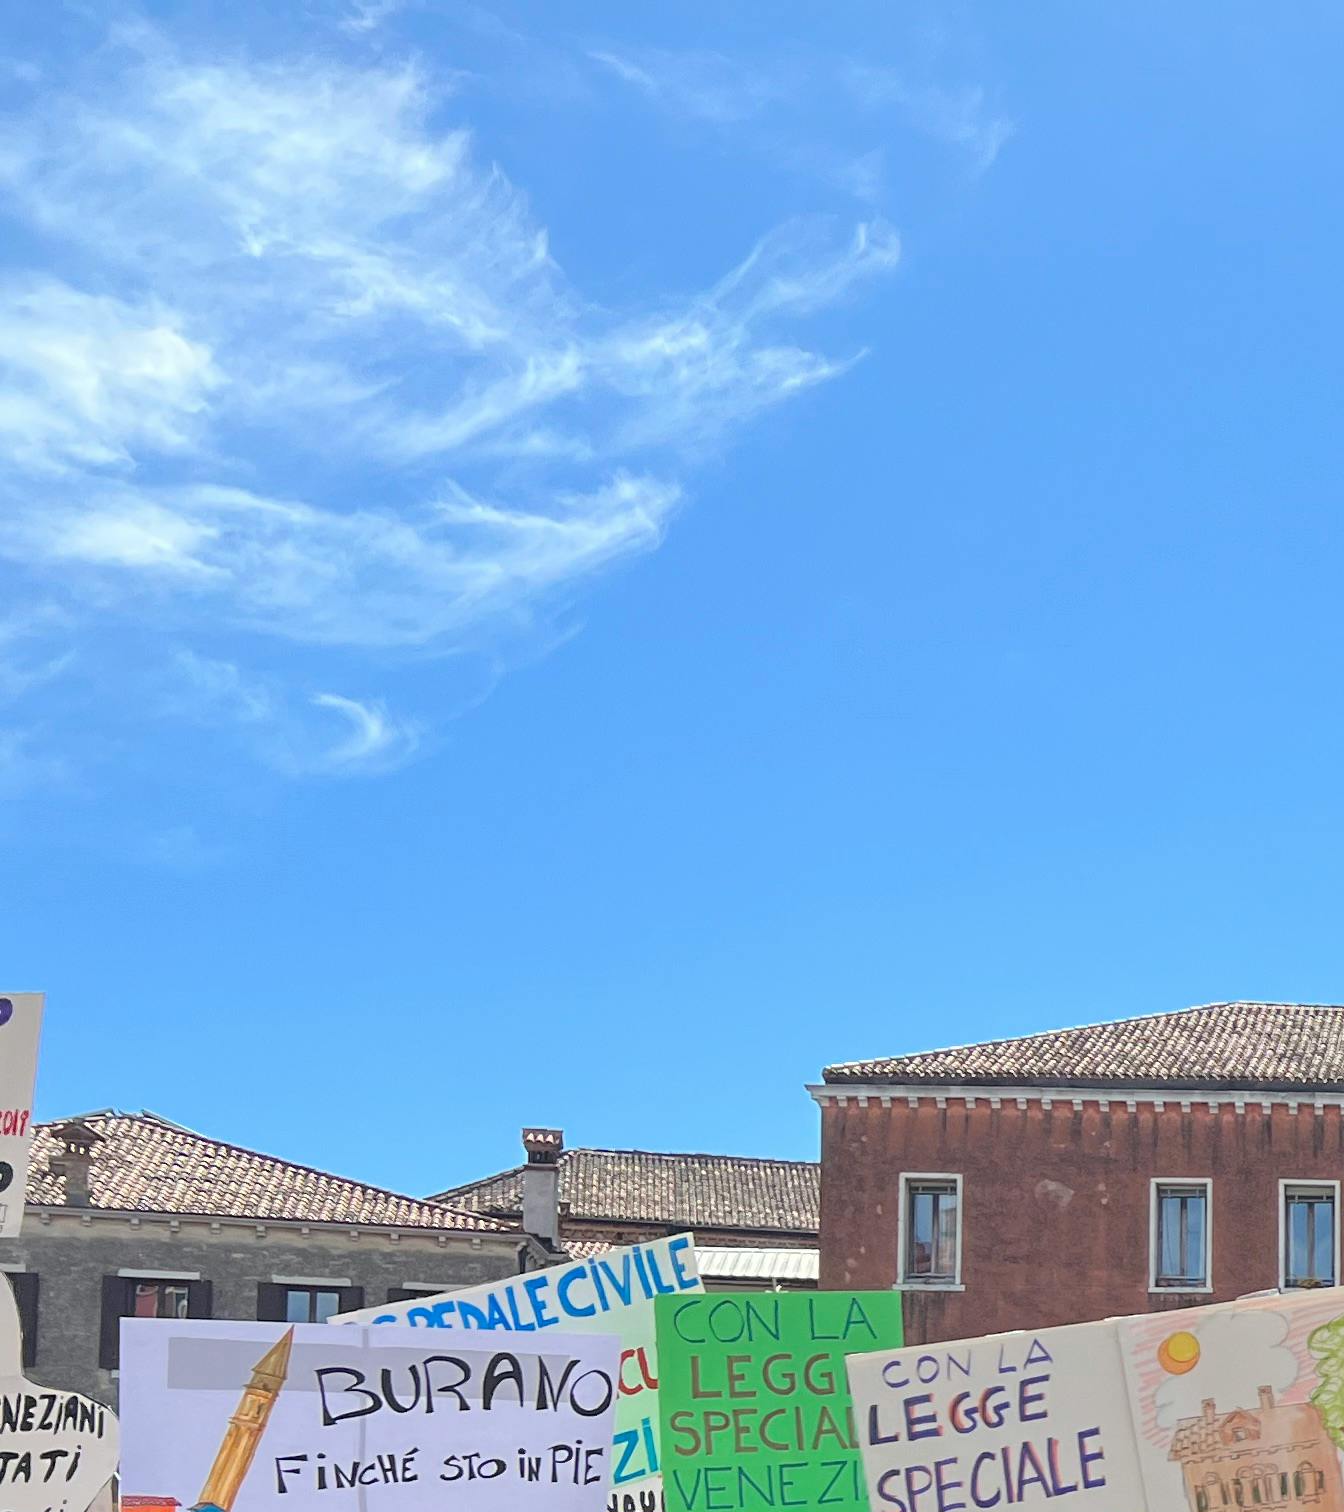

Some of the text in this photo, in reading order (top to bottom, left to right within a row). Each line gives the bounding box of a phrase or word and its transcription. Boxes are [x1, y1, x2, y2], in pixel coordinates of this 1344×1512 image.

[674, 1298, 878, 1344] CON LA
[692, 1352, 853, 1400] LEGG
[881, 1338, 1053, 1389] CON LA
[315, 1352, 612, 1427] BURANO
[869, 1374, 1052, 1446] LEGGE
[439, 1452, 508, 1482] STO
[673, 1459, 870, 1512] VENEZI
